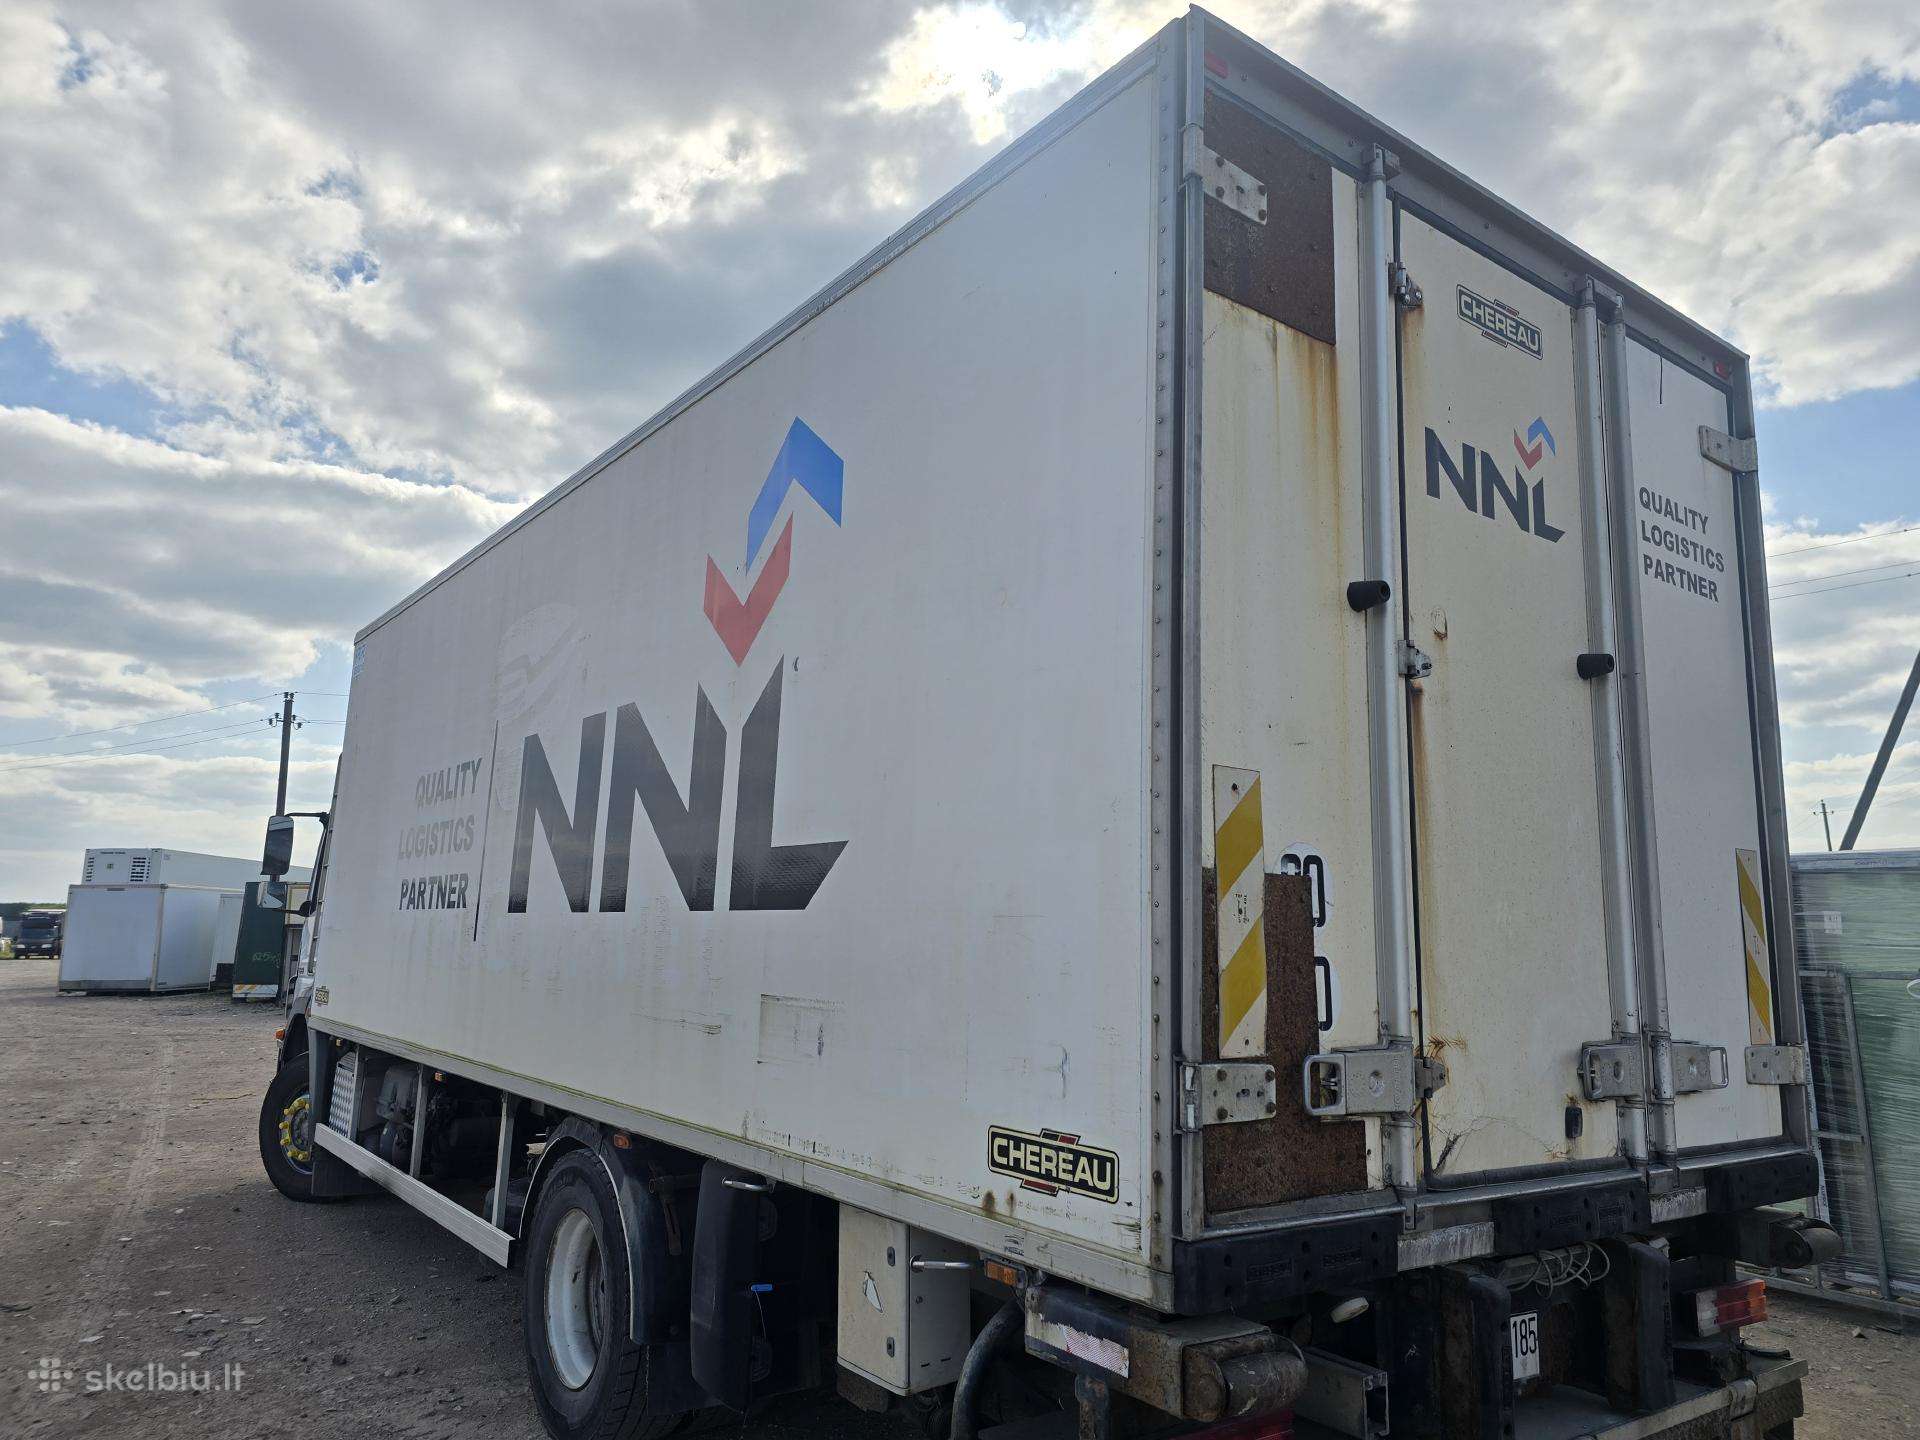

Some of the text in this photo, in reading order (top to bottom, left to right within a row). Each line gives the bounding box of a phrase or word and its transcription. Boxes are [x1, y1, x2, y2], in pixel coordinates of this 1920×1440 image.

[1460, 294, 1540, 353] CHEREAU
[1424, 426, 1566, 544] NNL
[1638, 486, 1709, 535] QUALITY
[1640, 520, 1725, 573] LOGISTICS
[1642, 554, 1719, 602] PARTNER
[416, 757, 482, 808] QUALITY
[507, 655, 849, 914] NNL
[398, 814, 475, 860] LOGISTICS
[399, 873, 469, 910] PARTNER
[992, 1137, 1112, 1192] CHEREAU
[1512, 1316, 1537, 1358] 185
